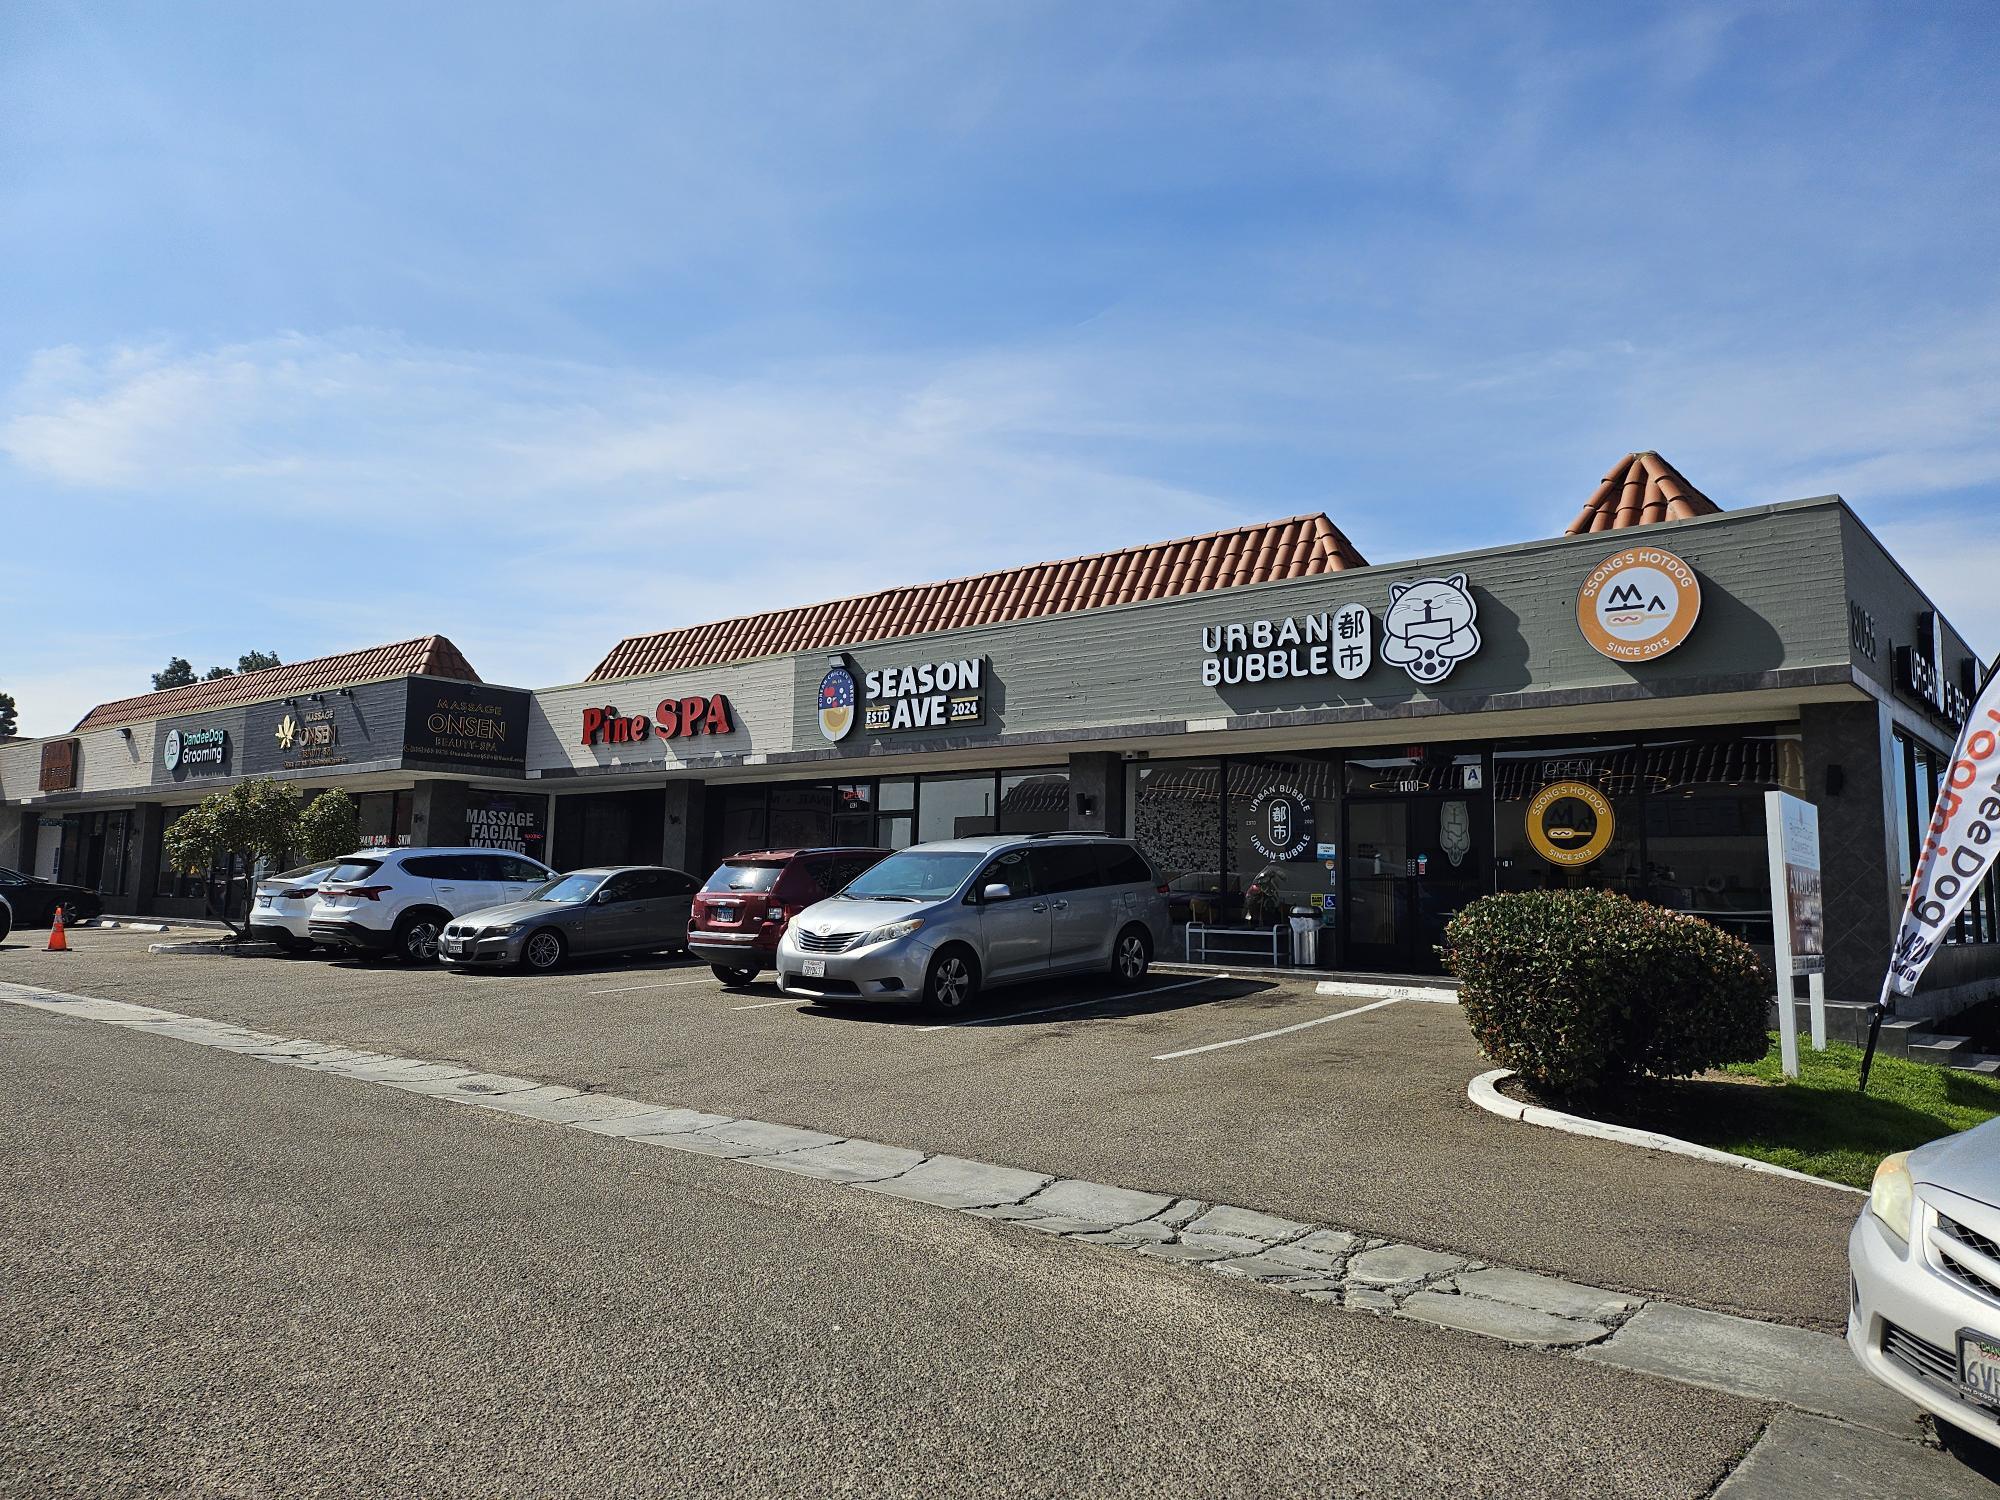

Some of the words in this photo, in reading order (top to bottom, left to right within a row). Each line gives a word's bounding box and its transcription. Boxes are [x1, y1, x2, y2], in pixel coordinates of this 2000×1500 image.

[1584, 553, 1634, 597] SSONG'S
[1639, 552, 1692, 587] HOTDOG
[1202, 613, 1328, 652] URBAN
[1337, 610, 1364, 671] 都市
[1606, 642, 1640, 655] SINCE
[1644, 637, 1670, 654] 2013
[865, 658, 980, 699] SEASON
[1202, 646, 1328, 687] BUBBLE
[437, 699, 502, 715] MASSAGE
[581, 705, 646, 745] Pine
[655, 694, 730, 739] SPA
[866, 711, 890, 724] ESTD
[892, 695, 947, 730] AVE
[952, 701, 977, 716] 2024
[183, 728, 224, 745] DandeeDog
[299, 724, 336, 746] ONSEN
[427, 712, 506, 742] ONSEN
[182, 746, 222, 763] Grooming
[1545, 761, 1590, 775] OPEN
[1401, 780, 1418, 791] 100
[1467, 768, 1478, 780] A
[1250, 785, 1276, 813] URBAN
[1279, 785, 1311, 812] BUBBLE
[1532, 786, 1567, 816] SSONG'S
[1570, 786, 1606, 815] HOTDOG
[466, 808, 534, 827] MASSAGE
[1272, 806, 1287, 839] 都市
[471, 824, 522, 841] FACIAL
[1250, 834, 1276, 860] URBAN
[1280, 833, 1311, 861] BUBBLE
[1549, 849, 1572, 860] SINCE
[1574, 849, 1592, 860] 2013
